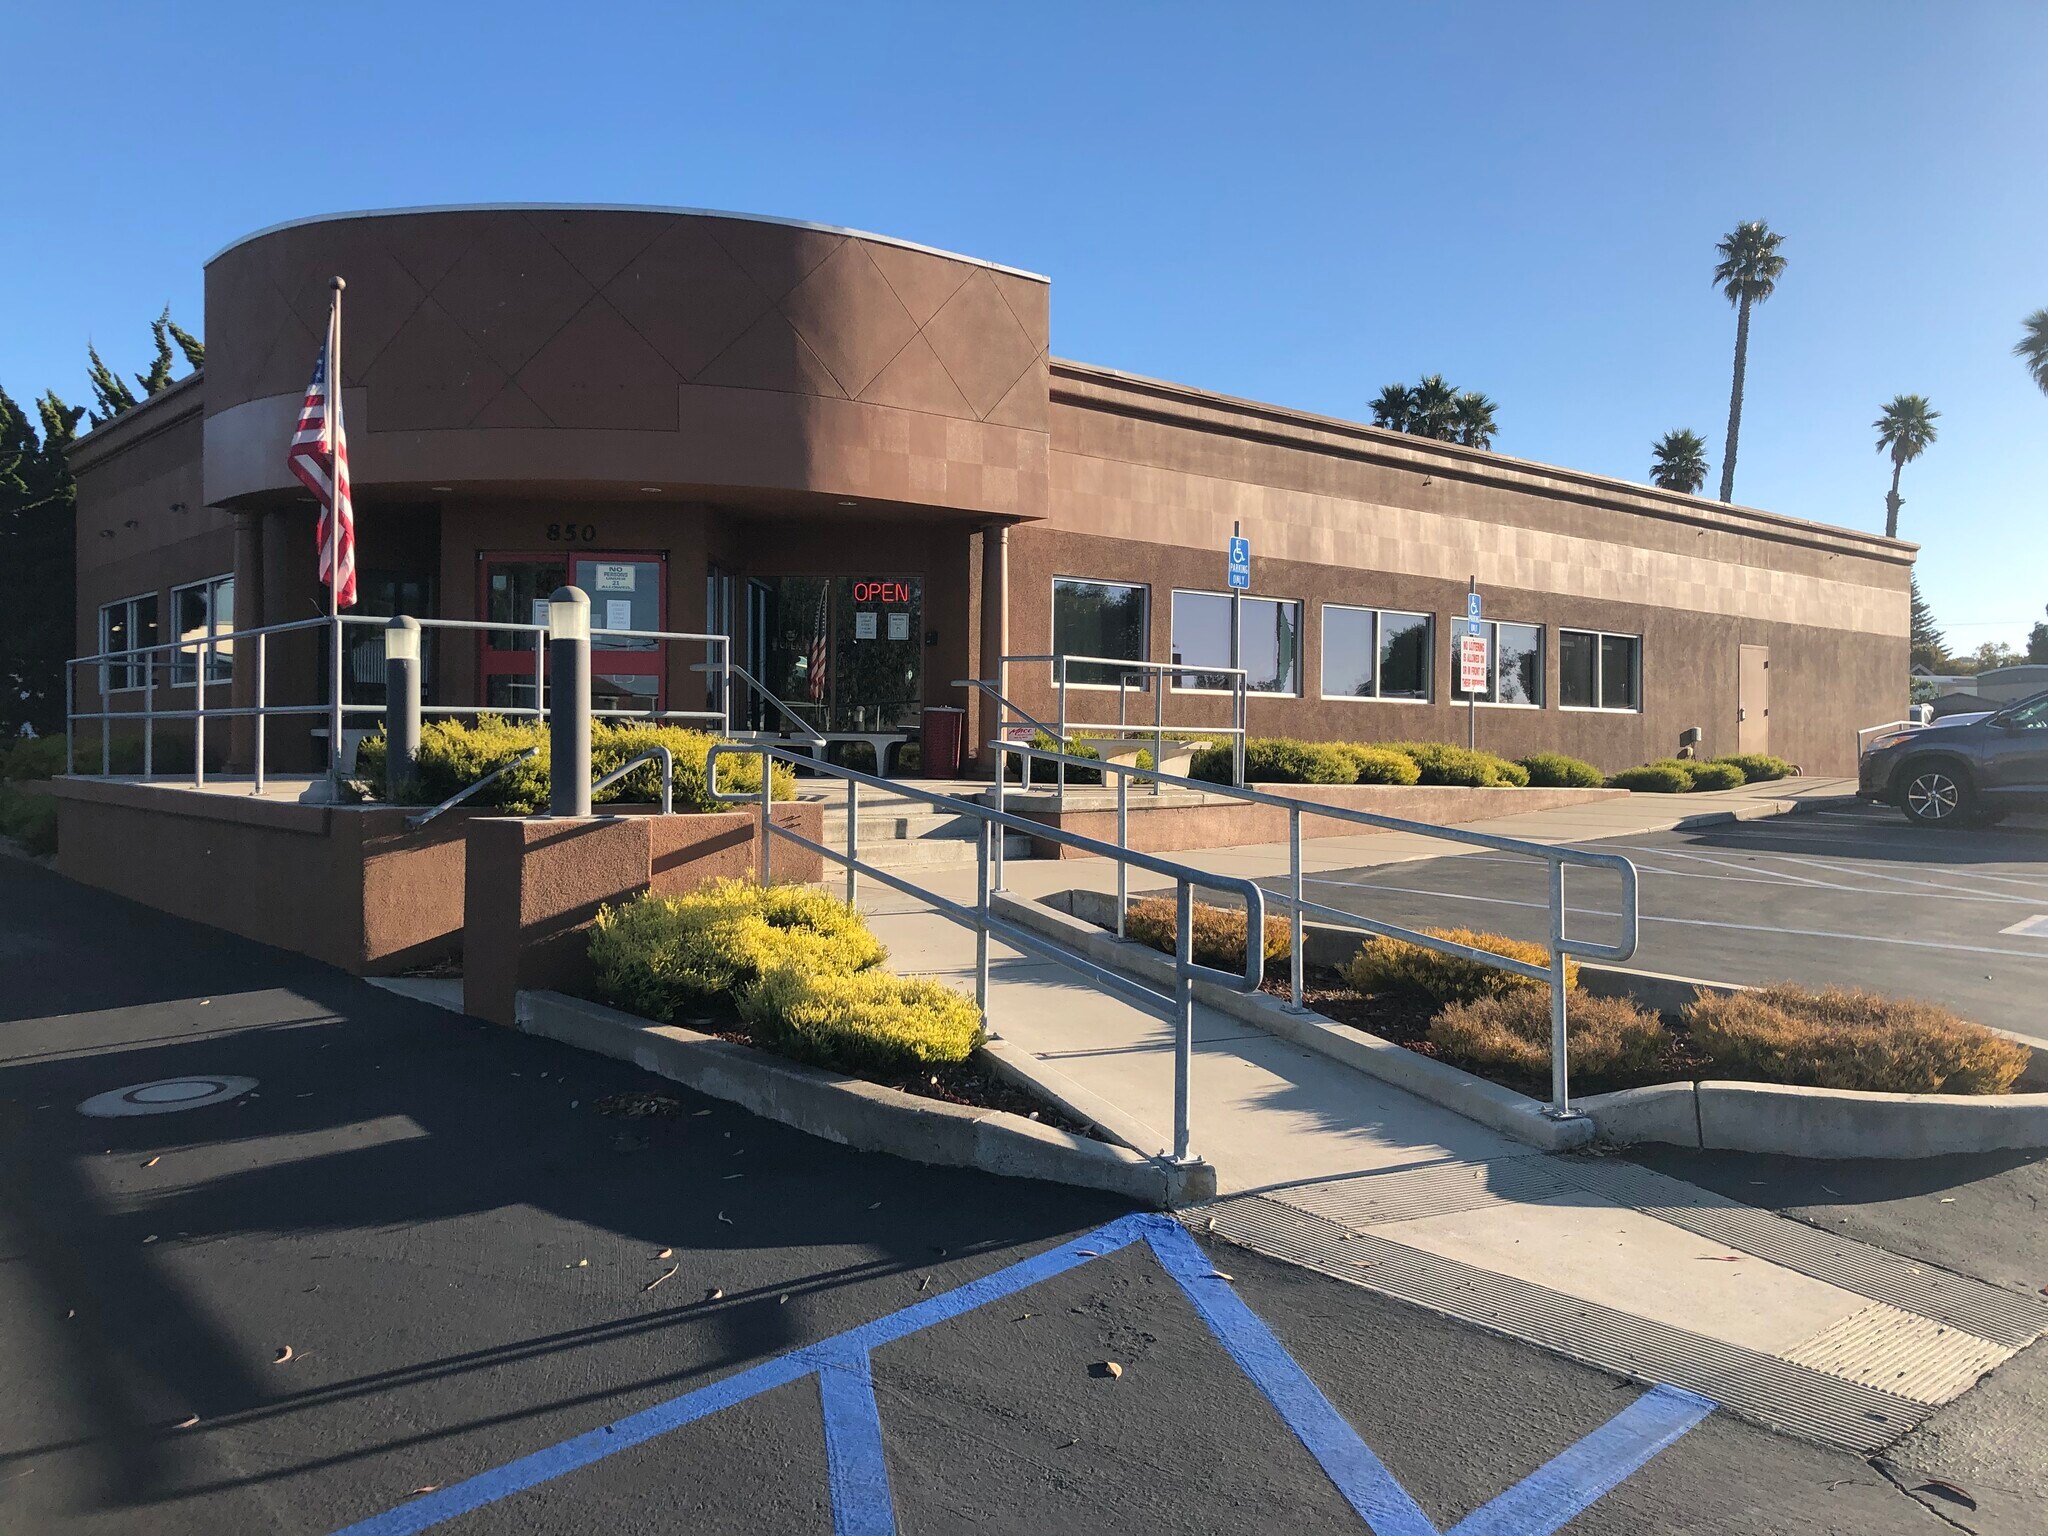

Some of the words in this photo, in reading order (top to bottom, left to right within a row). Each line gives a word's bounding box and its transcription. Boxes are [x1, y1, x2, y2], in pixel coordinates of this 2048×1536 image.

[546, 523, 596, 542] 850
[1230, 563, 1248, 574] PARKING
[1233, 575, 1246, 585] ONLY
[854, 583, 908, 601] OPEN
[1467, 653, 1479, 663] ALLOWED
